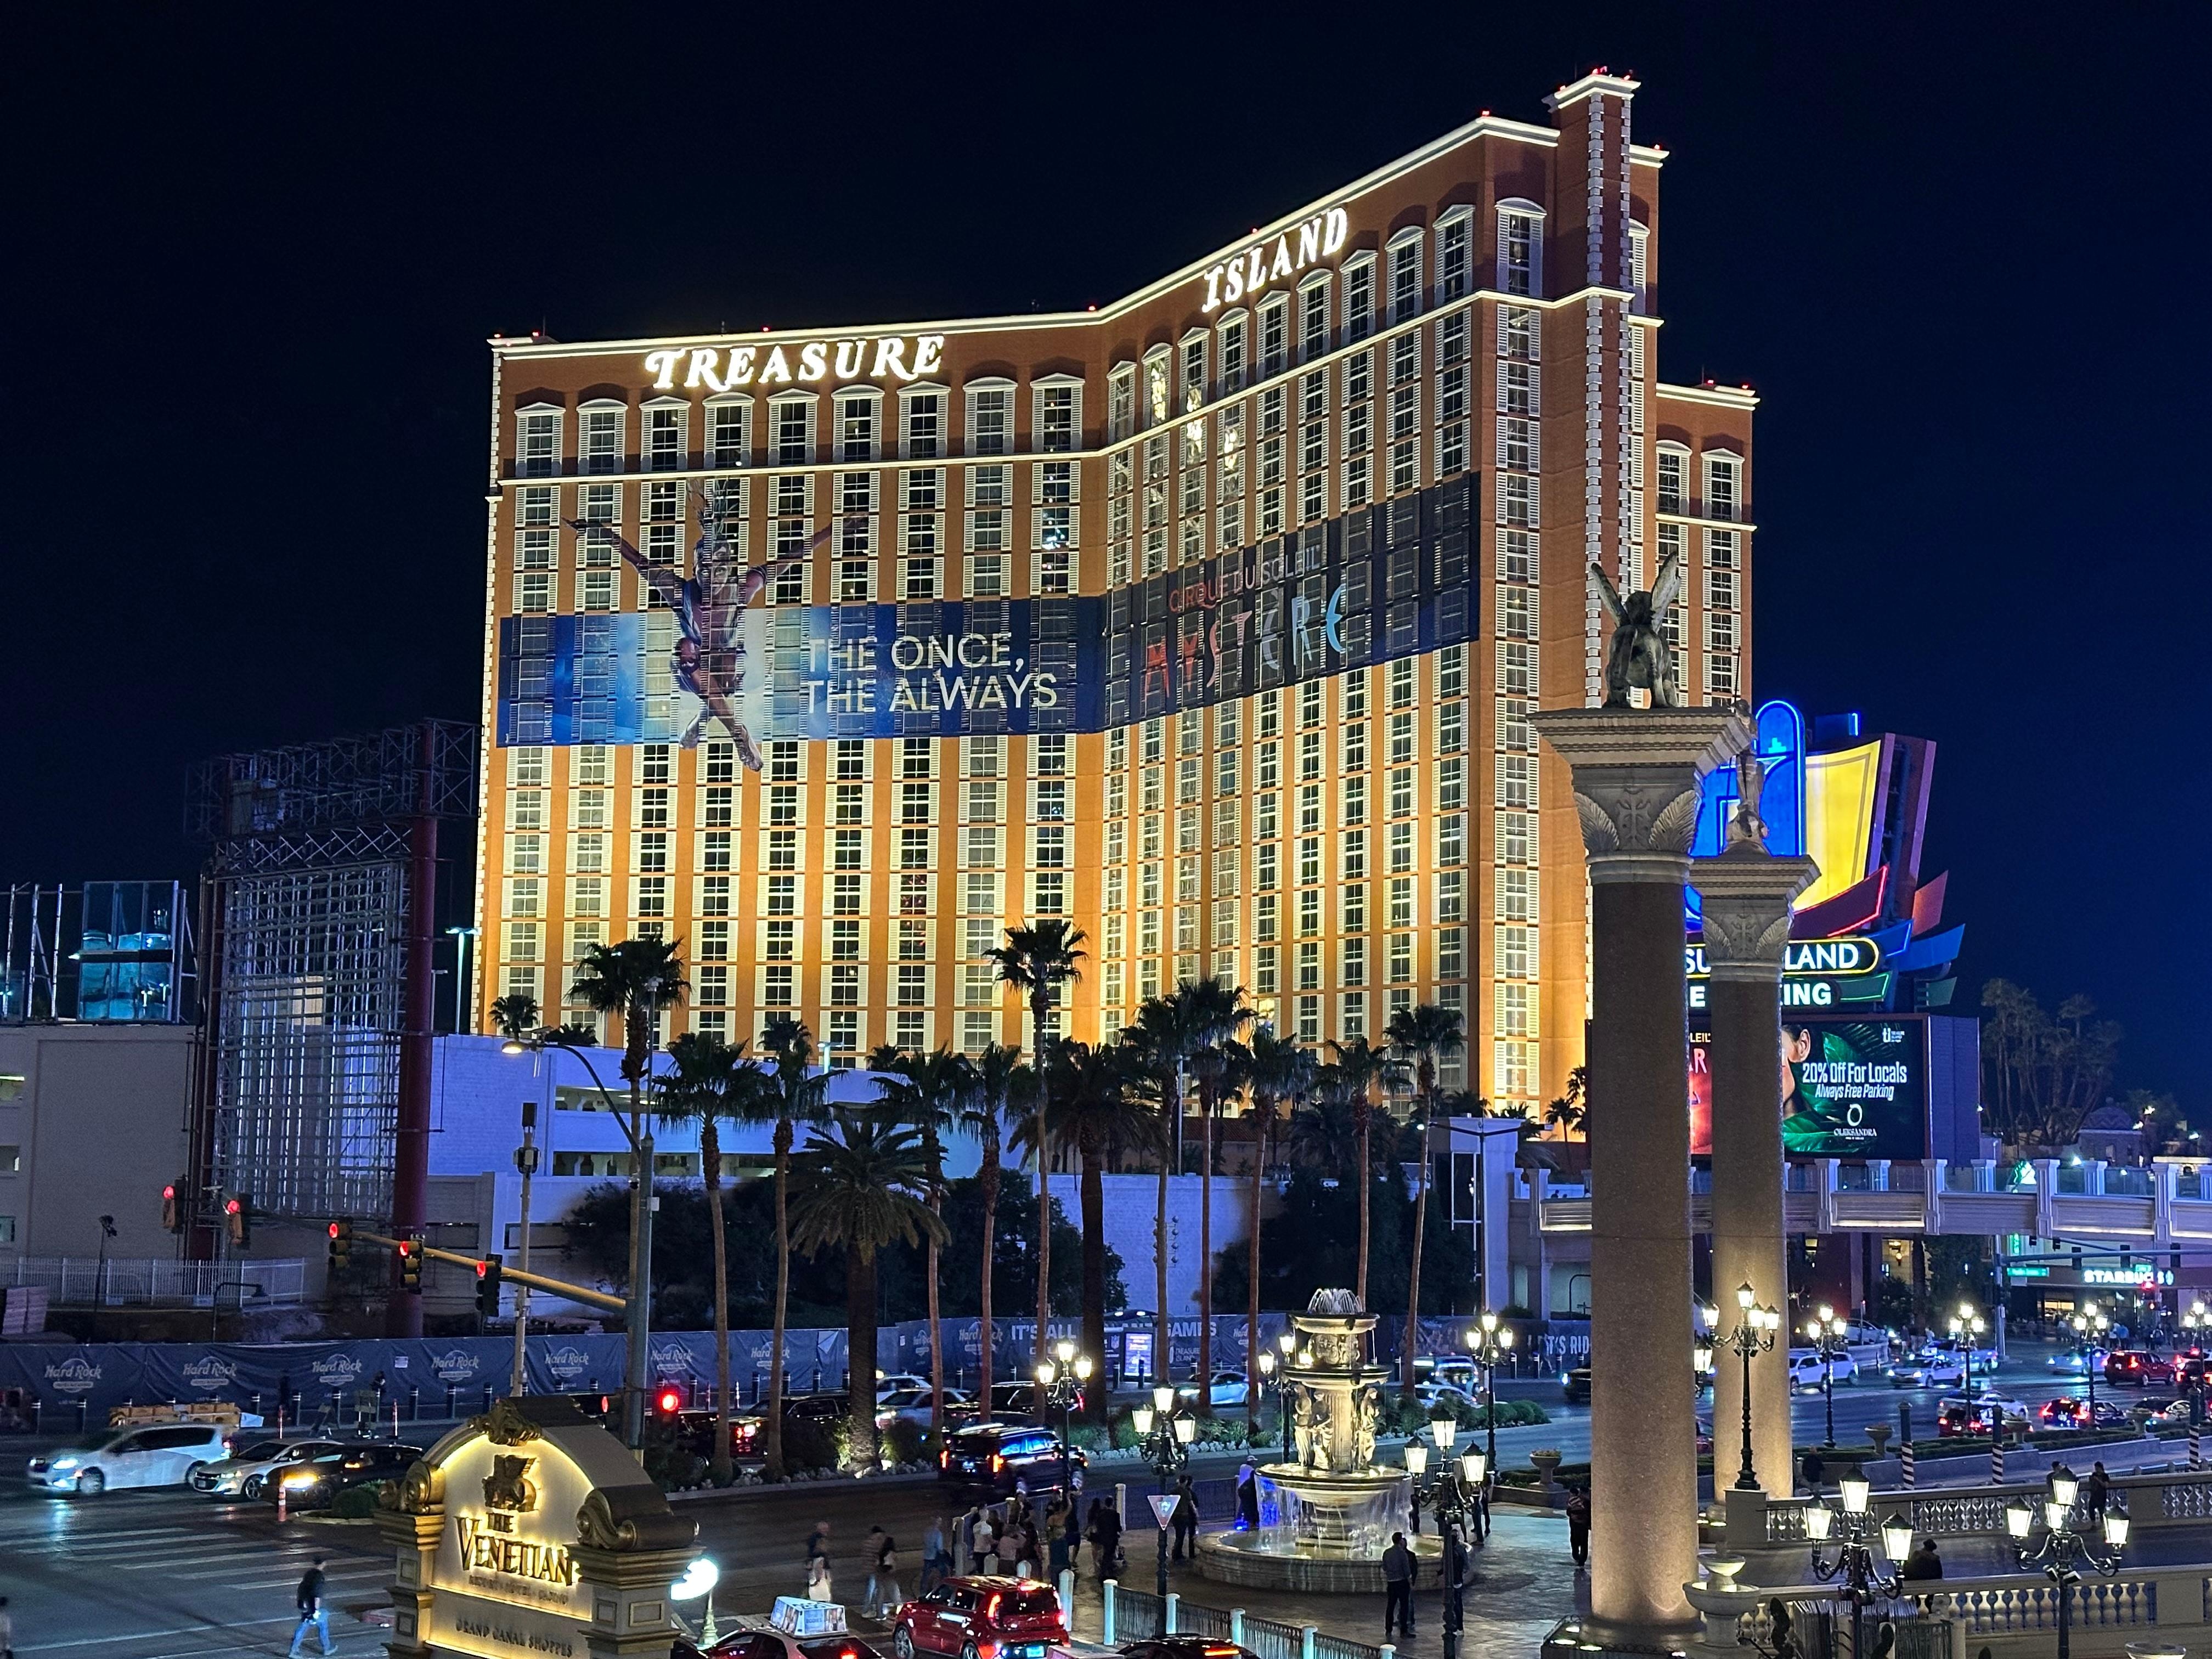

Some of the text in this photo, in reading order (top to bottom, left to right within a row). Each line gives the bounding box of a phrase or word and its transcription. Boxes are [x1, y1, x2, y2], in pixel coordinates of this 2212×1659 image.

[1201, 207, 1347, 313] ISLAND
[645, 335, 944, 391] TREASURE
[1169, 544, 1320, 613] CIRQUE DU SOLEIL
[808, 632, 1024, 673] THE ONCE,
[808, 673, 1057, 713] THE ALWAYS
[1785, 943, 1858, 970] LAND
[1780, 983, 1831, 1006] ING
[1689, 1032, 1711, 1042] LEIL
[1802, 1061, 1908, 1083] 20% Off For Locals
[1815, 1084, 1894, 1101] Always Free Parking
[2084, 1269, 2164, 1284] STARBUCS
[959, 1329, 978, 1342] Hard
[1045, 1324, 1076, 1339] ALL
[751, 1347, 771, 1358] Hard
[1570, 1335, 1590, 1355] RID
[431, 1356, 479, 1369] Hard Rock
[545, 1352, 589, 1365] Hard Rock
[651, 1350, 692, 1362] Hard Rock
[44, 1364, 102, 1379] Hard Rock
[183, 1363, 237, 1376] Hard Rock
[312, 1358, 362, 1373] Hard Rock
[486, 1511, 515, 1533] THE
[454, 1516, 573, 1587] VENETIAN
[455, 1617, 573, 1658] GRAND CANAL SHOPPES
